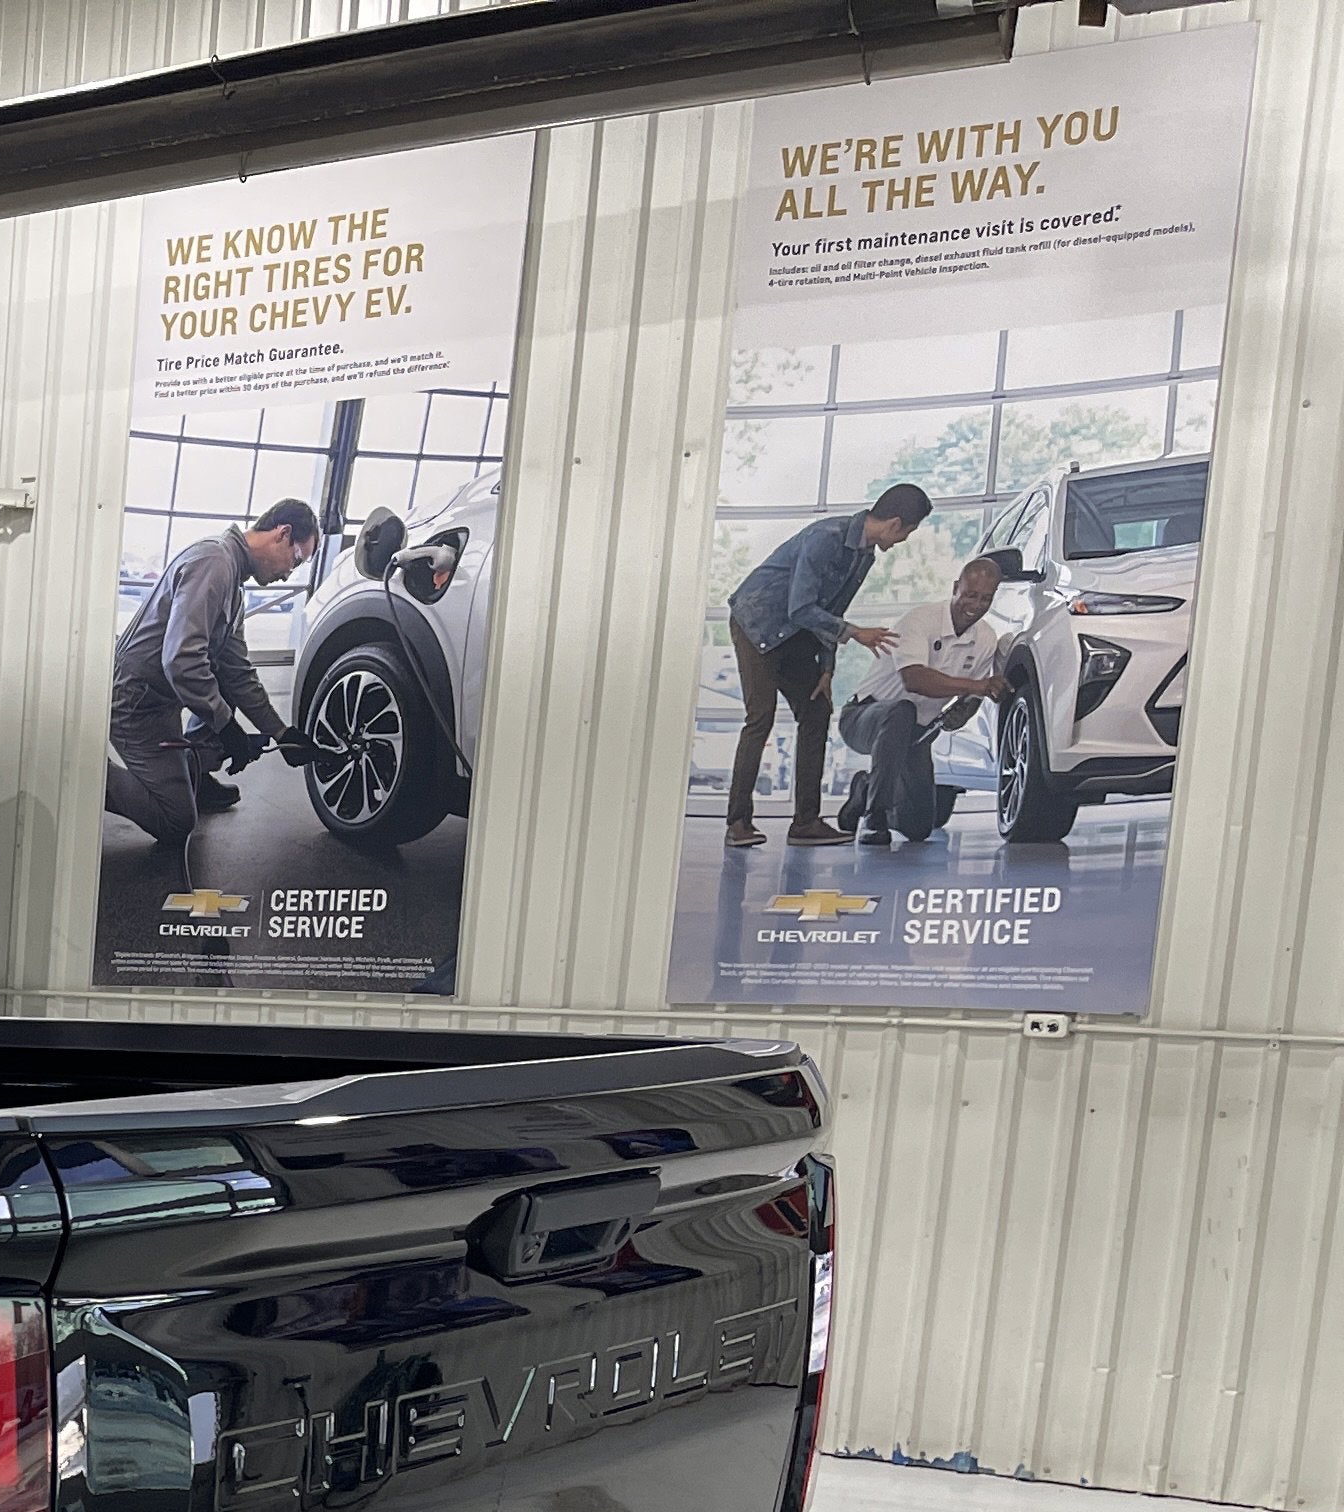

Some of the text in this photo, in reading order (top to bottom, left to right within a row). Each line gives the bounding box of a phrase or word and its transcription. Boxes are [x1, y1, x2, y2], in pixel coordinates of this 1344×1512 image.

[917, 119, 1023, 165] WITH
[1035, 106, 1120, 149] YOU
[774, 160, 1047, 222] ALL THE WAY.
[166, 207, 390, 267] WE KNOW THE
[769, 221, 1196, 276] Includes: oil and oil filter change, diesel exhaust fluid tank refill (for diesel-equipped models),
[772, 242, 811, 257] Your
[815, 238, 853, 254] first
[857, 226, 972, 251] maintenance
[975, 220, 1014, 239] visit
[1019, 217, 1035, 234] is
[162, 242, 426, 305] RIGHT TIRES FOR
[768, 278, 794, 288] 4-tire
[795, 275, 834, 287] rotation,
[835, 272, 852, 284] and
[853, 269, 903, 282] Multi-Point
[904, 266, 938, 278] Vehicle
[160, 284, 413, 342] YOUR CHEVY EV.
[155, 380, 182, 389] Provide
[192, 377, 209, 387] with
[215, 375, 239, 385] better
[239, 371, 265, 383] eligible
[266, 370, 285, 381] price
[286, 368, 295, 377] at
[296, 367, 308, 376] the
[309, 366, 326, 375] time
[327, 363, 336, 373] of
[336, 359, 374, 373] purchase,
[374, 357, 390, 368] and
[409, 351, 435, 362] match
[435, 350, 445, 360] it.
[157, 343, 345, 372] Tire Price Match Guarantee.
[154, 390, 171, 399] Find
[176, 387, 200, 398] better
[199, 387, 218, 398] price
[218, 385, 242, 395] within
[242, 383, 253, 392] 30
[253, 382, 271, 392] days
[271, 381, 280, 390] of
[280, 380, 293, 389] the
[293, 376, 330, 389] purchase,
[331, 373, 346, 384] and
[365, 368, 392, 379] refund
[392, 366, 406, 376] the
[270, 888, 387, 913] CERTIFIED
[906, 887, 1062, 914] CERTIFIED
[159, 923, 252, 938] CHEVROLET
[267, 914, 365, 939] SERVICE
[756, 929, 881, 944] CHEVROLET
[902, 918, 1031, 945] SERVICE
[217, 1298, 799, 1512] CHEVROLET
